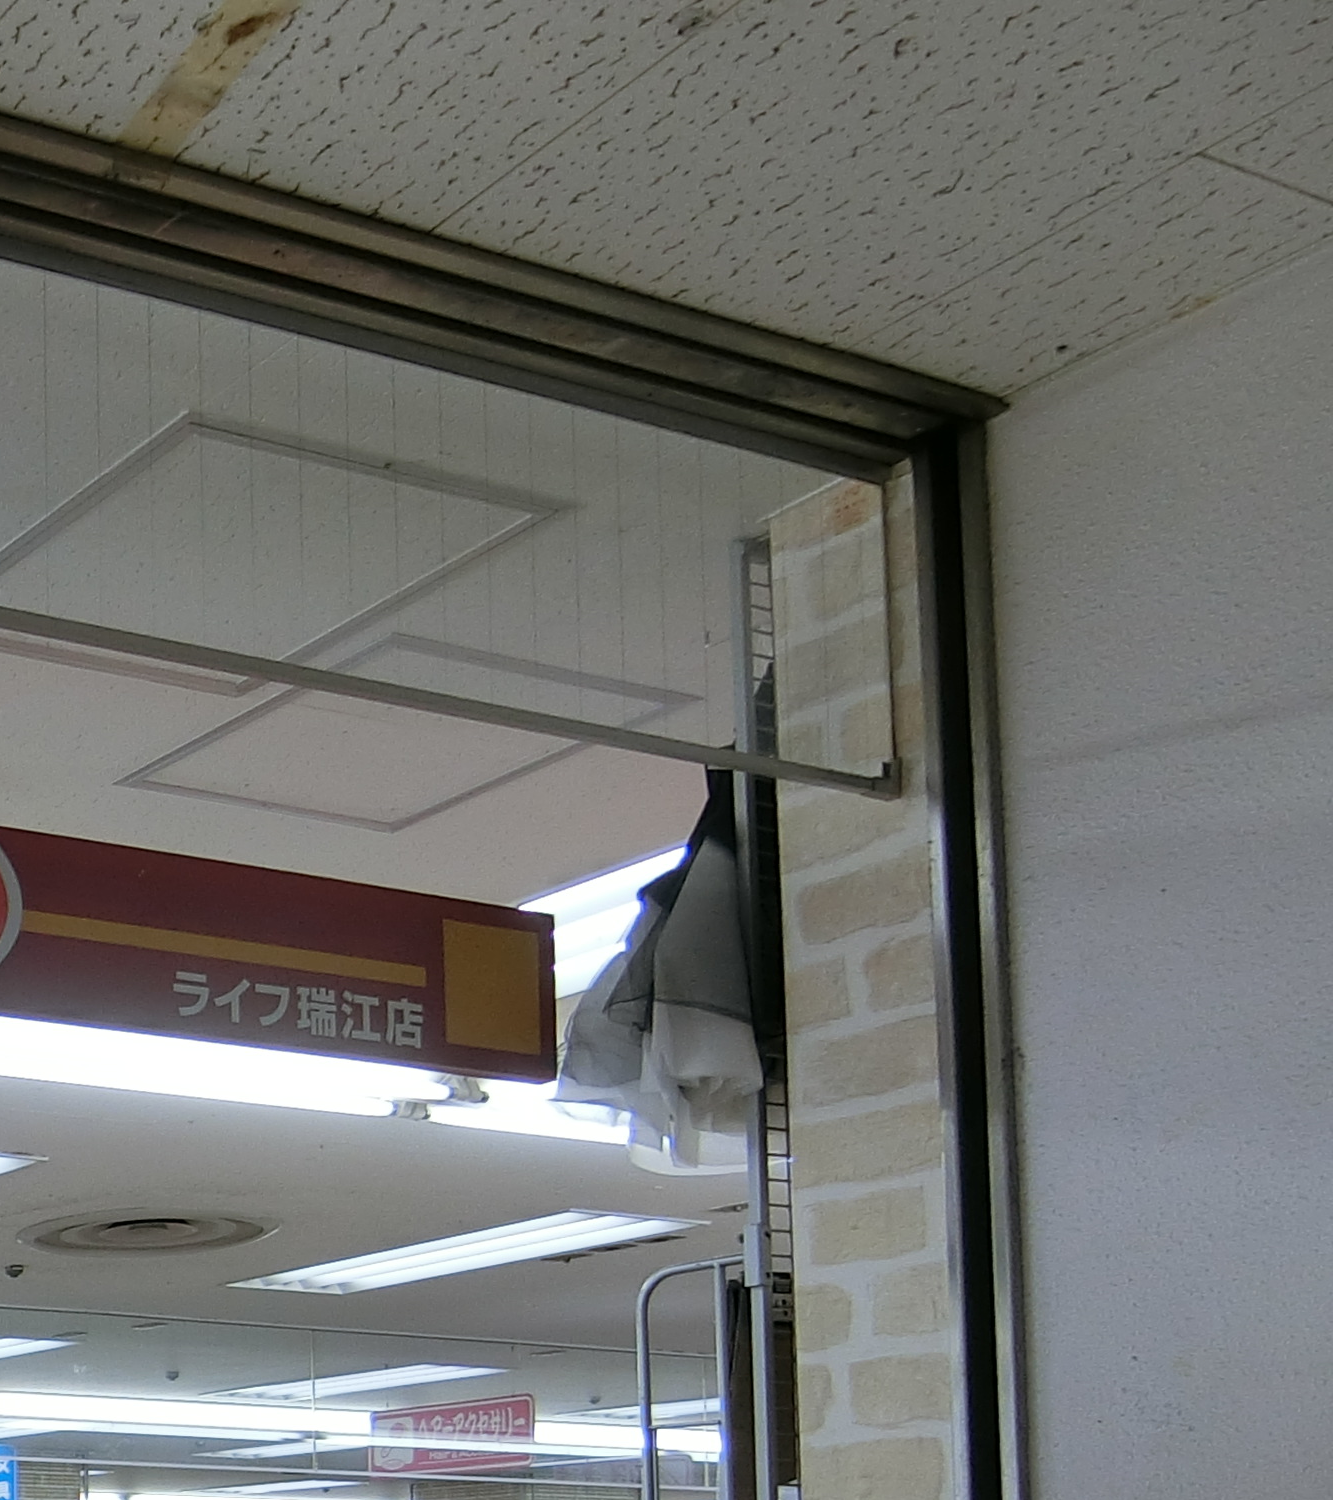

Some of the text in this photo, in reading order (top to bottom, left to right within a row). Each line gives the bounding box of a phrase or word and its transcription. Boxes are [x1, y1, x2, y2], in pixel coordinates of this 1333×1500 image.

[172, 971, 425, 1049] ライフ瑞江店
